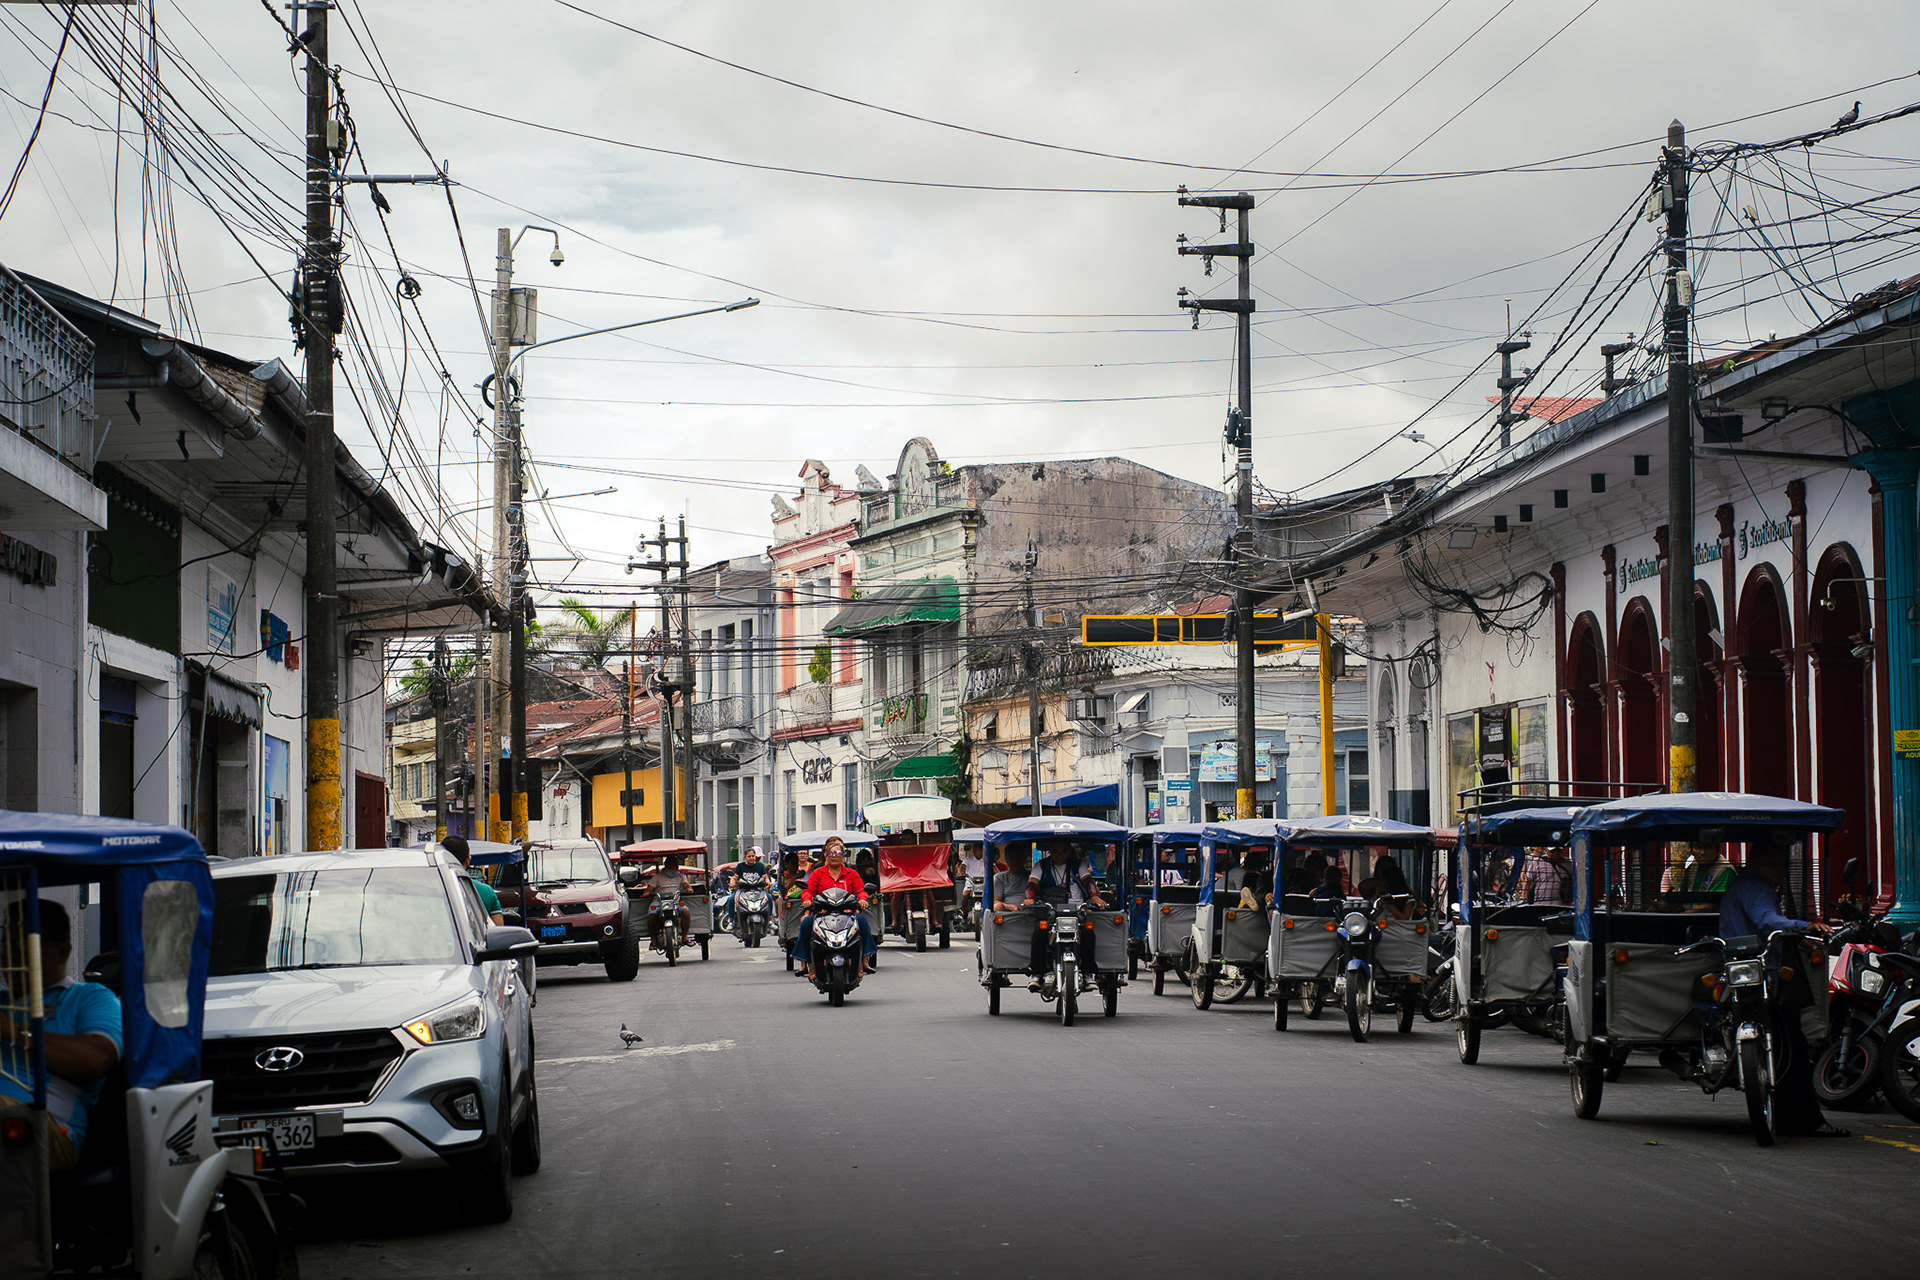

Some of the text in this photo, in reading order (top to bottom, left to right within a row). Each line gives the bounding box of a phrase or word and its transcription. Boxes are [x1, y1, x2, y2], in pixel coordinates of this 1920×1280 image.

[1750, 515, 1792, 548] Scotiabank
[1695, 538, 1721, 565] tiabank
[1628, 555, 1660, 583] Scotiabank
[0, 840, 45, 850] TOKAR
[102, 835, 161, 846] MOTOKAR
[265, 1119, 291, 1127] PERU
